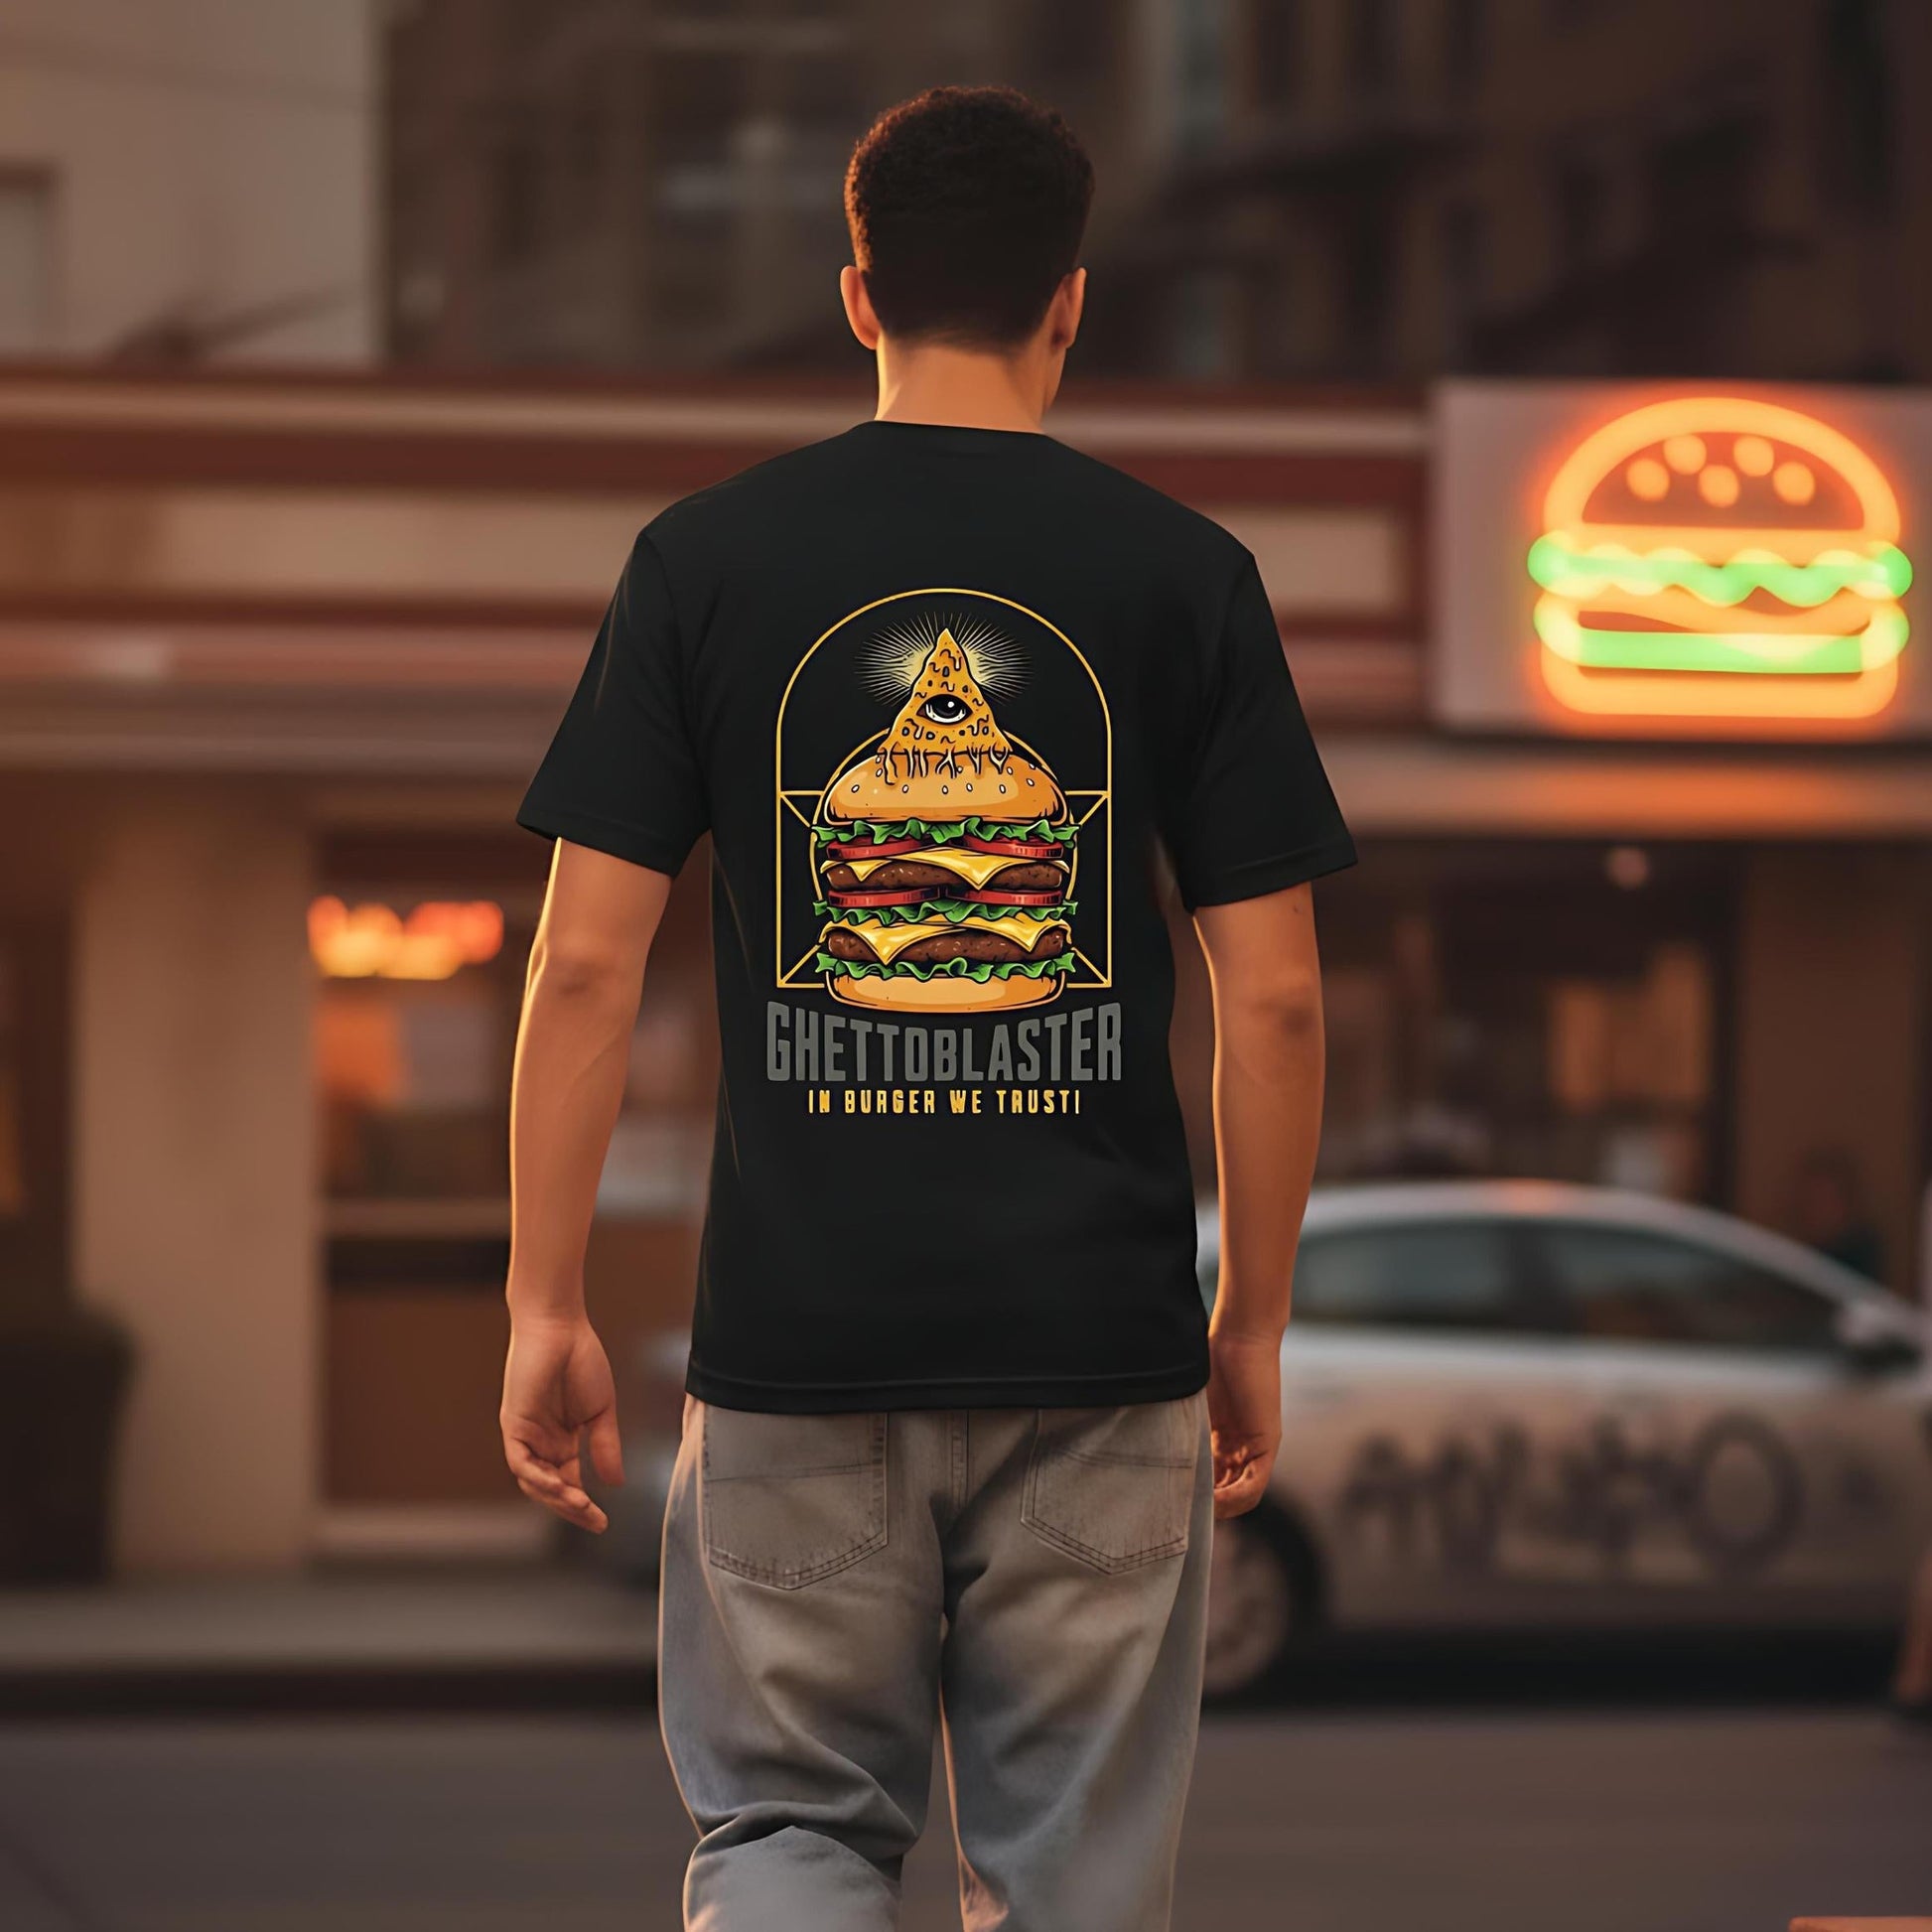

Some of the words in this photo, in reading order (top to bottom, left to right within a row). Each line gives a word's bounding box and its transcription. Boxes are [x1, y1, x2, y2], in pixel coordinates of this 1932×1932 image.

[766, 1001, 1122, 1081] GHETTOBLASTER
[808, 1089, 831, 1113] IN
[844, 1089, 935, 1114] BURGER
[949, 1089, 983, 1114] WE
